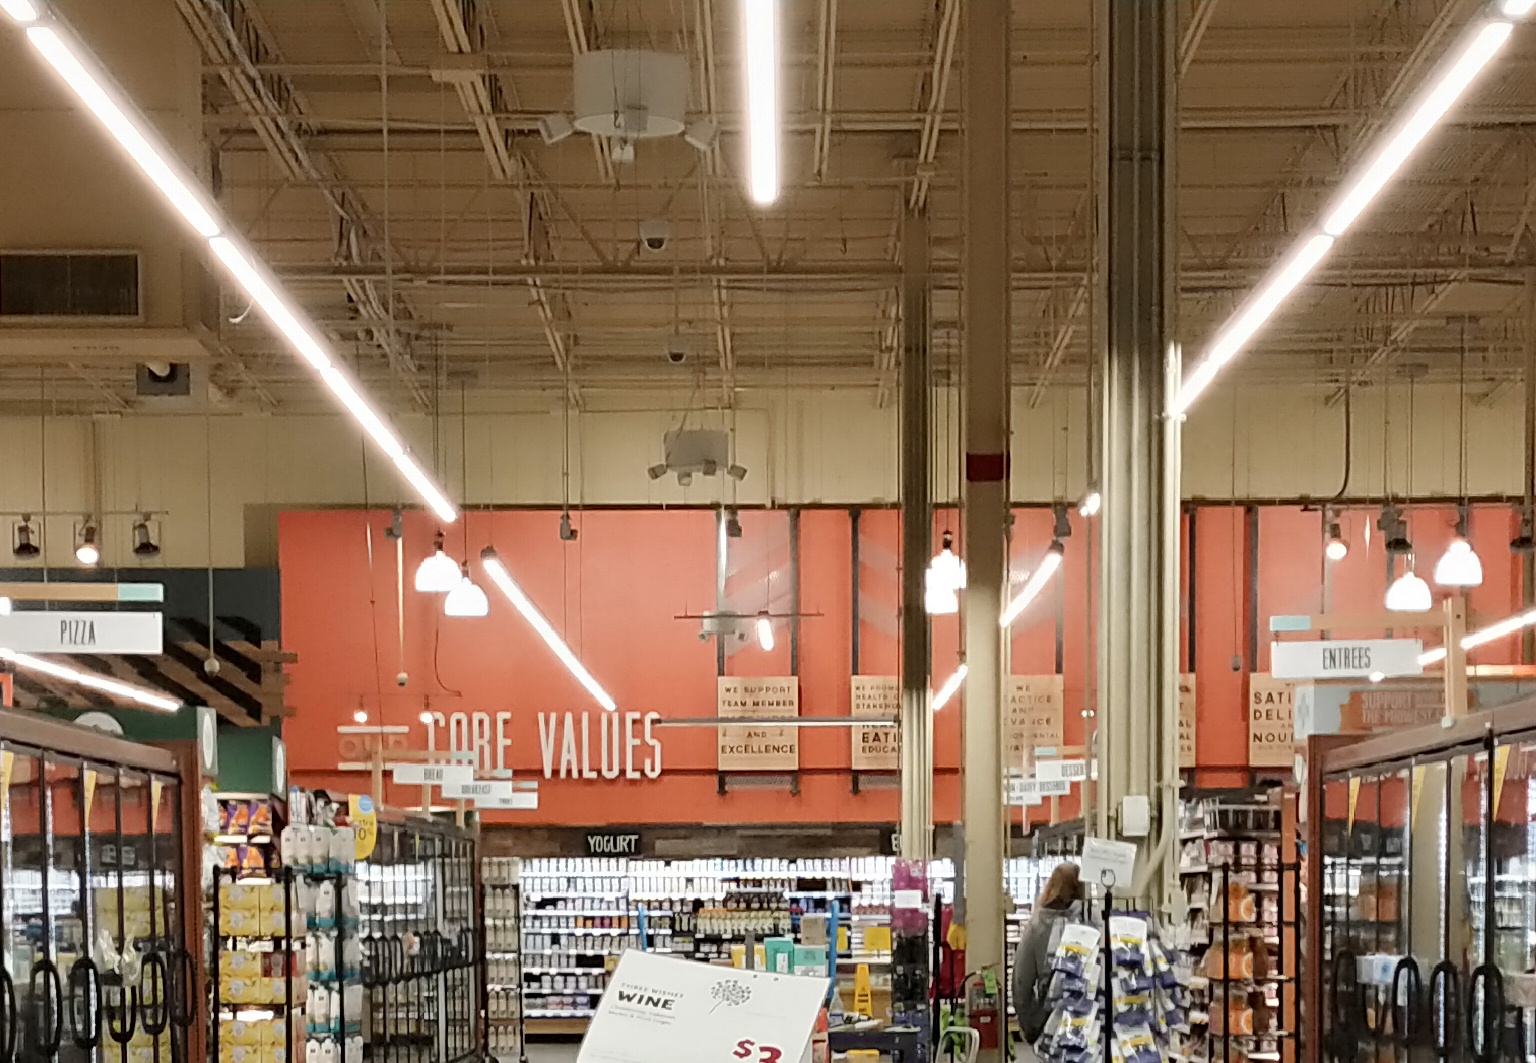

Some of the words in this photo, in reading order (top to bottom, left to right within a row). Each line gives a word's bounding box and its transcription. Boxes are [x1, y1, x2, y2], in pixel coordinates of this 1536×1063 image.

[60, 620, 96, 645] PIZZA
[1322, 648, 1371, 670] ENTREES
[725, 686, 738, 694] WE
[744, 686, 791, 694] SUPPORT
[753, 700, 795, 708] MEMBER
[1253, 691, 1293, 705] SATI
[1253, 709, 1293, 721] DELI
[746, 731, 767, 739] AND
[537, 711, 662, 779] VALUES
[721, 744, 796, 754] EXCELLENCE
[861, 746, 901, 754] EDUCA
[1061, 763, 1086, 778] DESSER
[587, 834, 640, 853] YOGURT
[617, 990, 677, 1011] WINE
